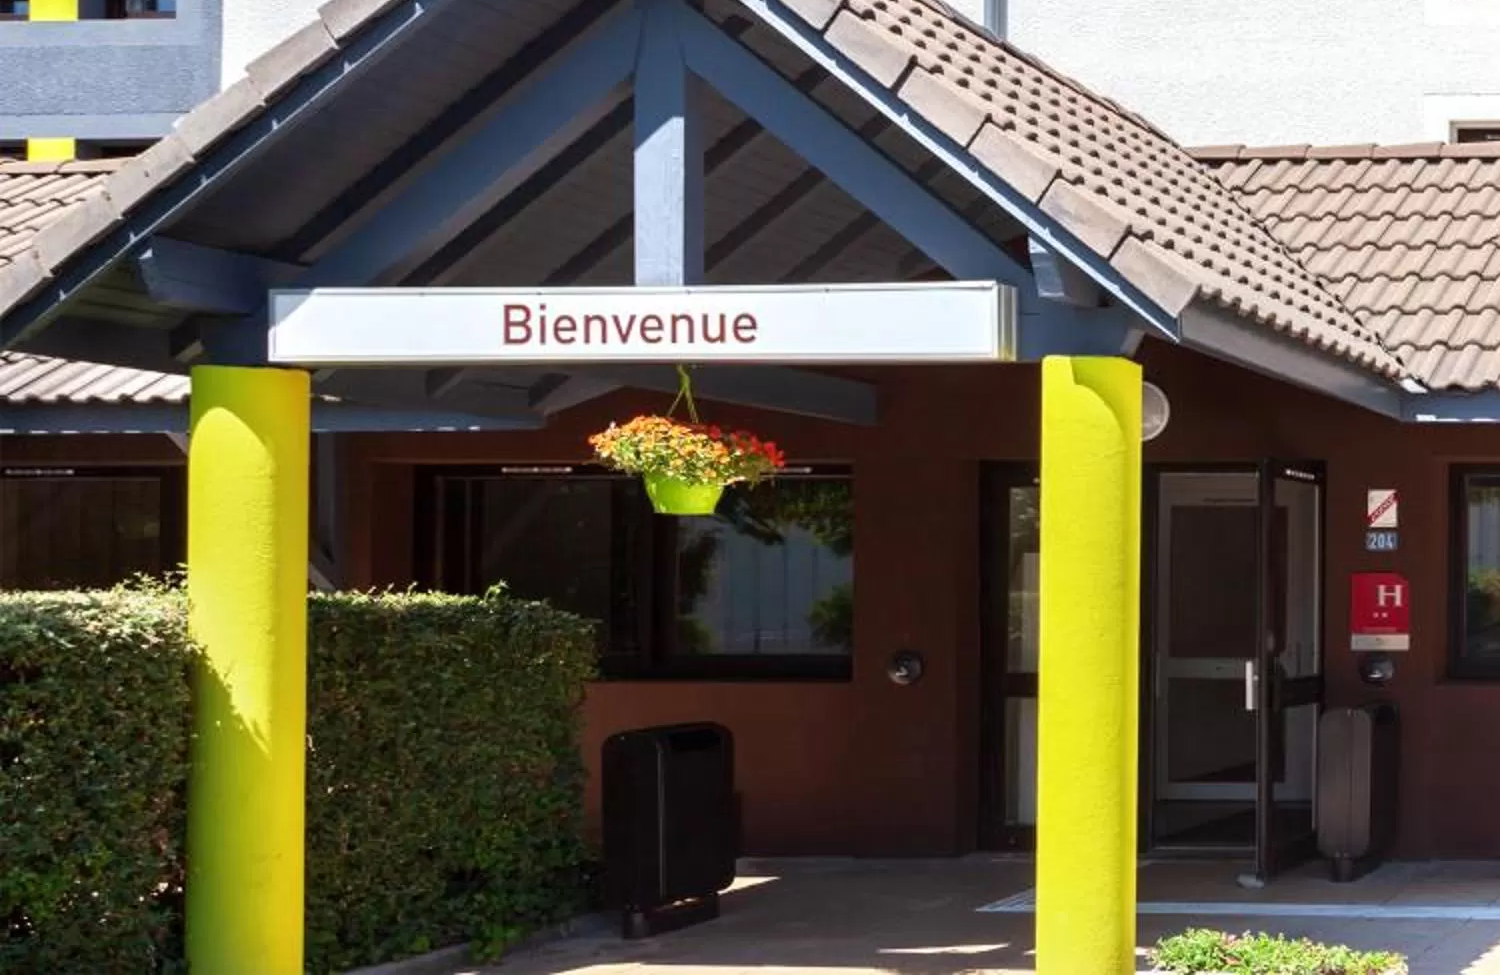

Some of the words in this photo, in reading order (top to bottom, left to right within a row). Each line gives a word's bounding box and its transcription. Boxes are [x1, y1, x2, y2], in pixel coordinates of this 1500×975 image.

[503, 303, 758, 345] Bienvenue
[1367, 532, 1395, 550] 204
[1378, 584, 1402, 607] H
